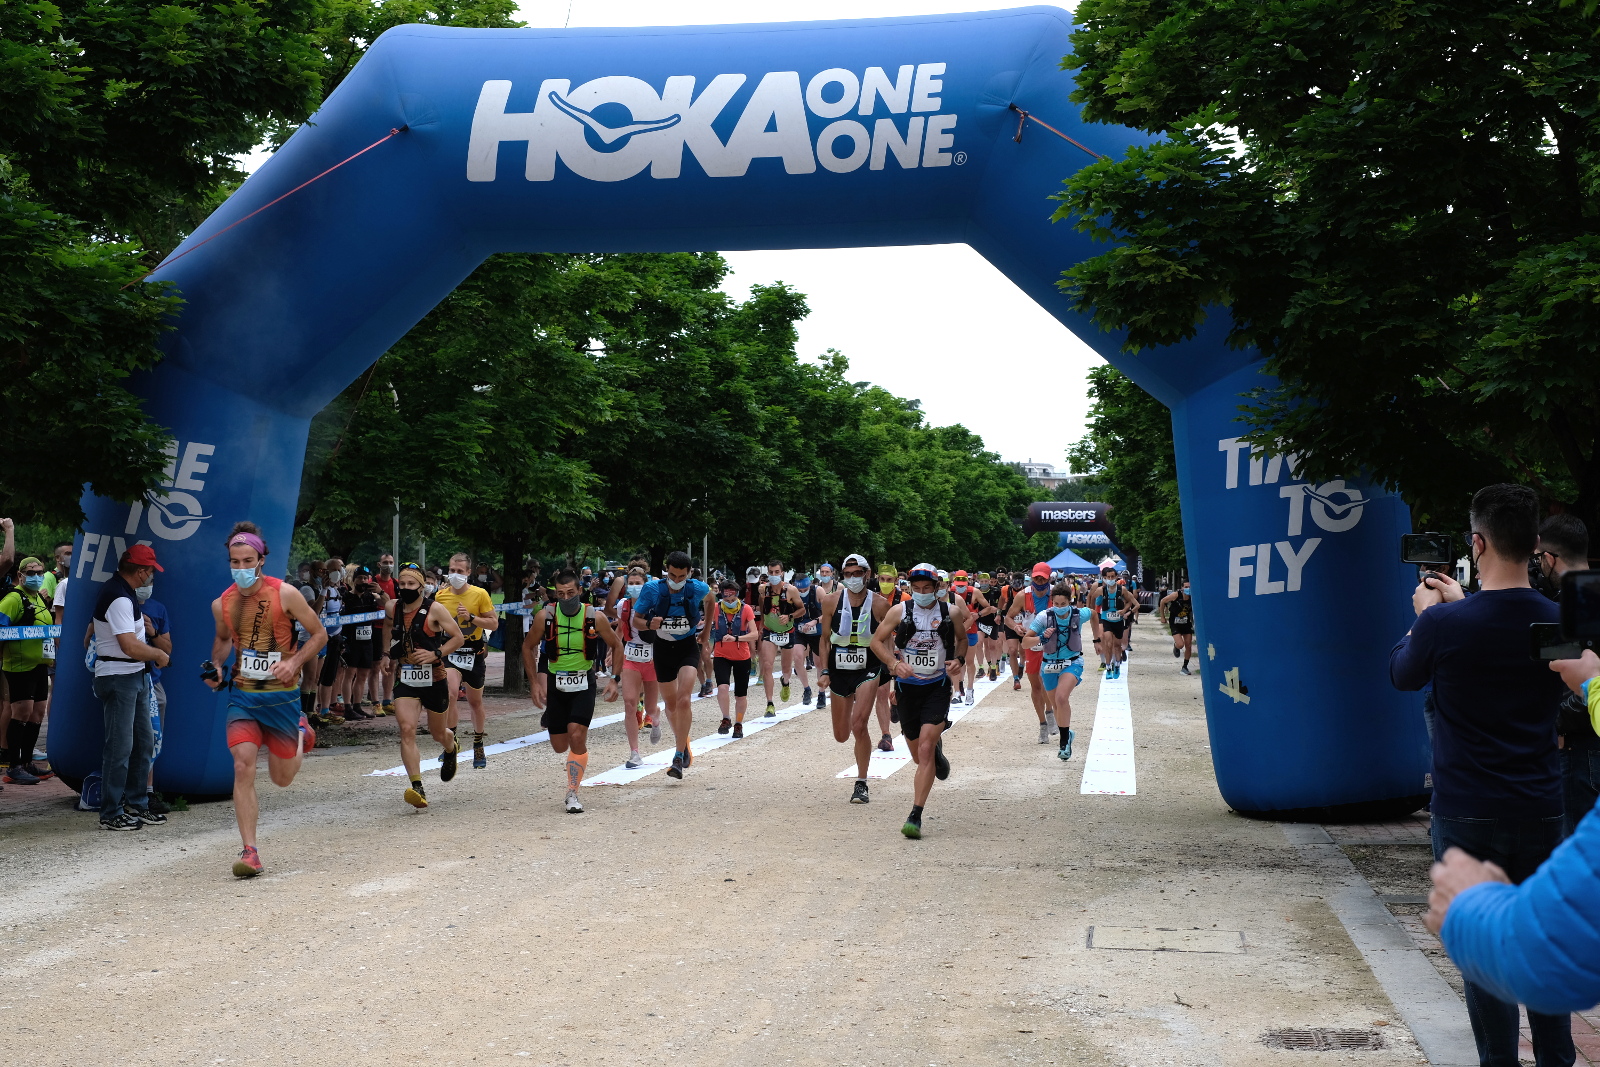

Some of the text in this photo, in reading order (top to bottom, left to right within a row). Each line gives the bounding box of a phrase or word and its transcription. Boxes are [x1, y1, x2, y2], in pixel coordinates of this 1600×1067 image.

[806, 63, 946, 119] ONE
[466, 71, 816, 182] HOKA
[817, 114, 957, 174] ONE
[1219, 436, 1308, 490] TIM
[1279, 479, 1366, 536] TO
[1041, 508, 1096, 520] masters
[1067, 534, 1098, 544] HOKA
[1228, 537, 1322, 598] FLY
[628, 647, 649, 657] 1.015
[837, 653, 864, 663] 1.006
[449, 655, 473, 665] 1.012
[906, 655, 935, 667] 1.005
[403, 670, 430, 680] 1.008
[557, 674, 586, 685] 1.007
